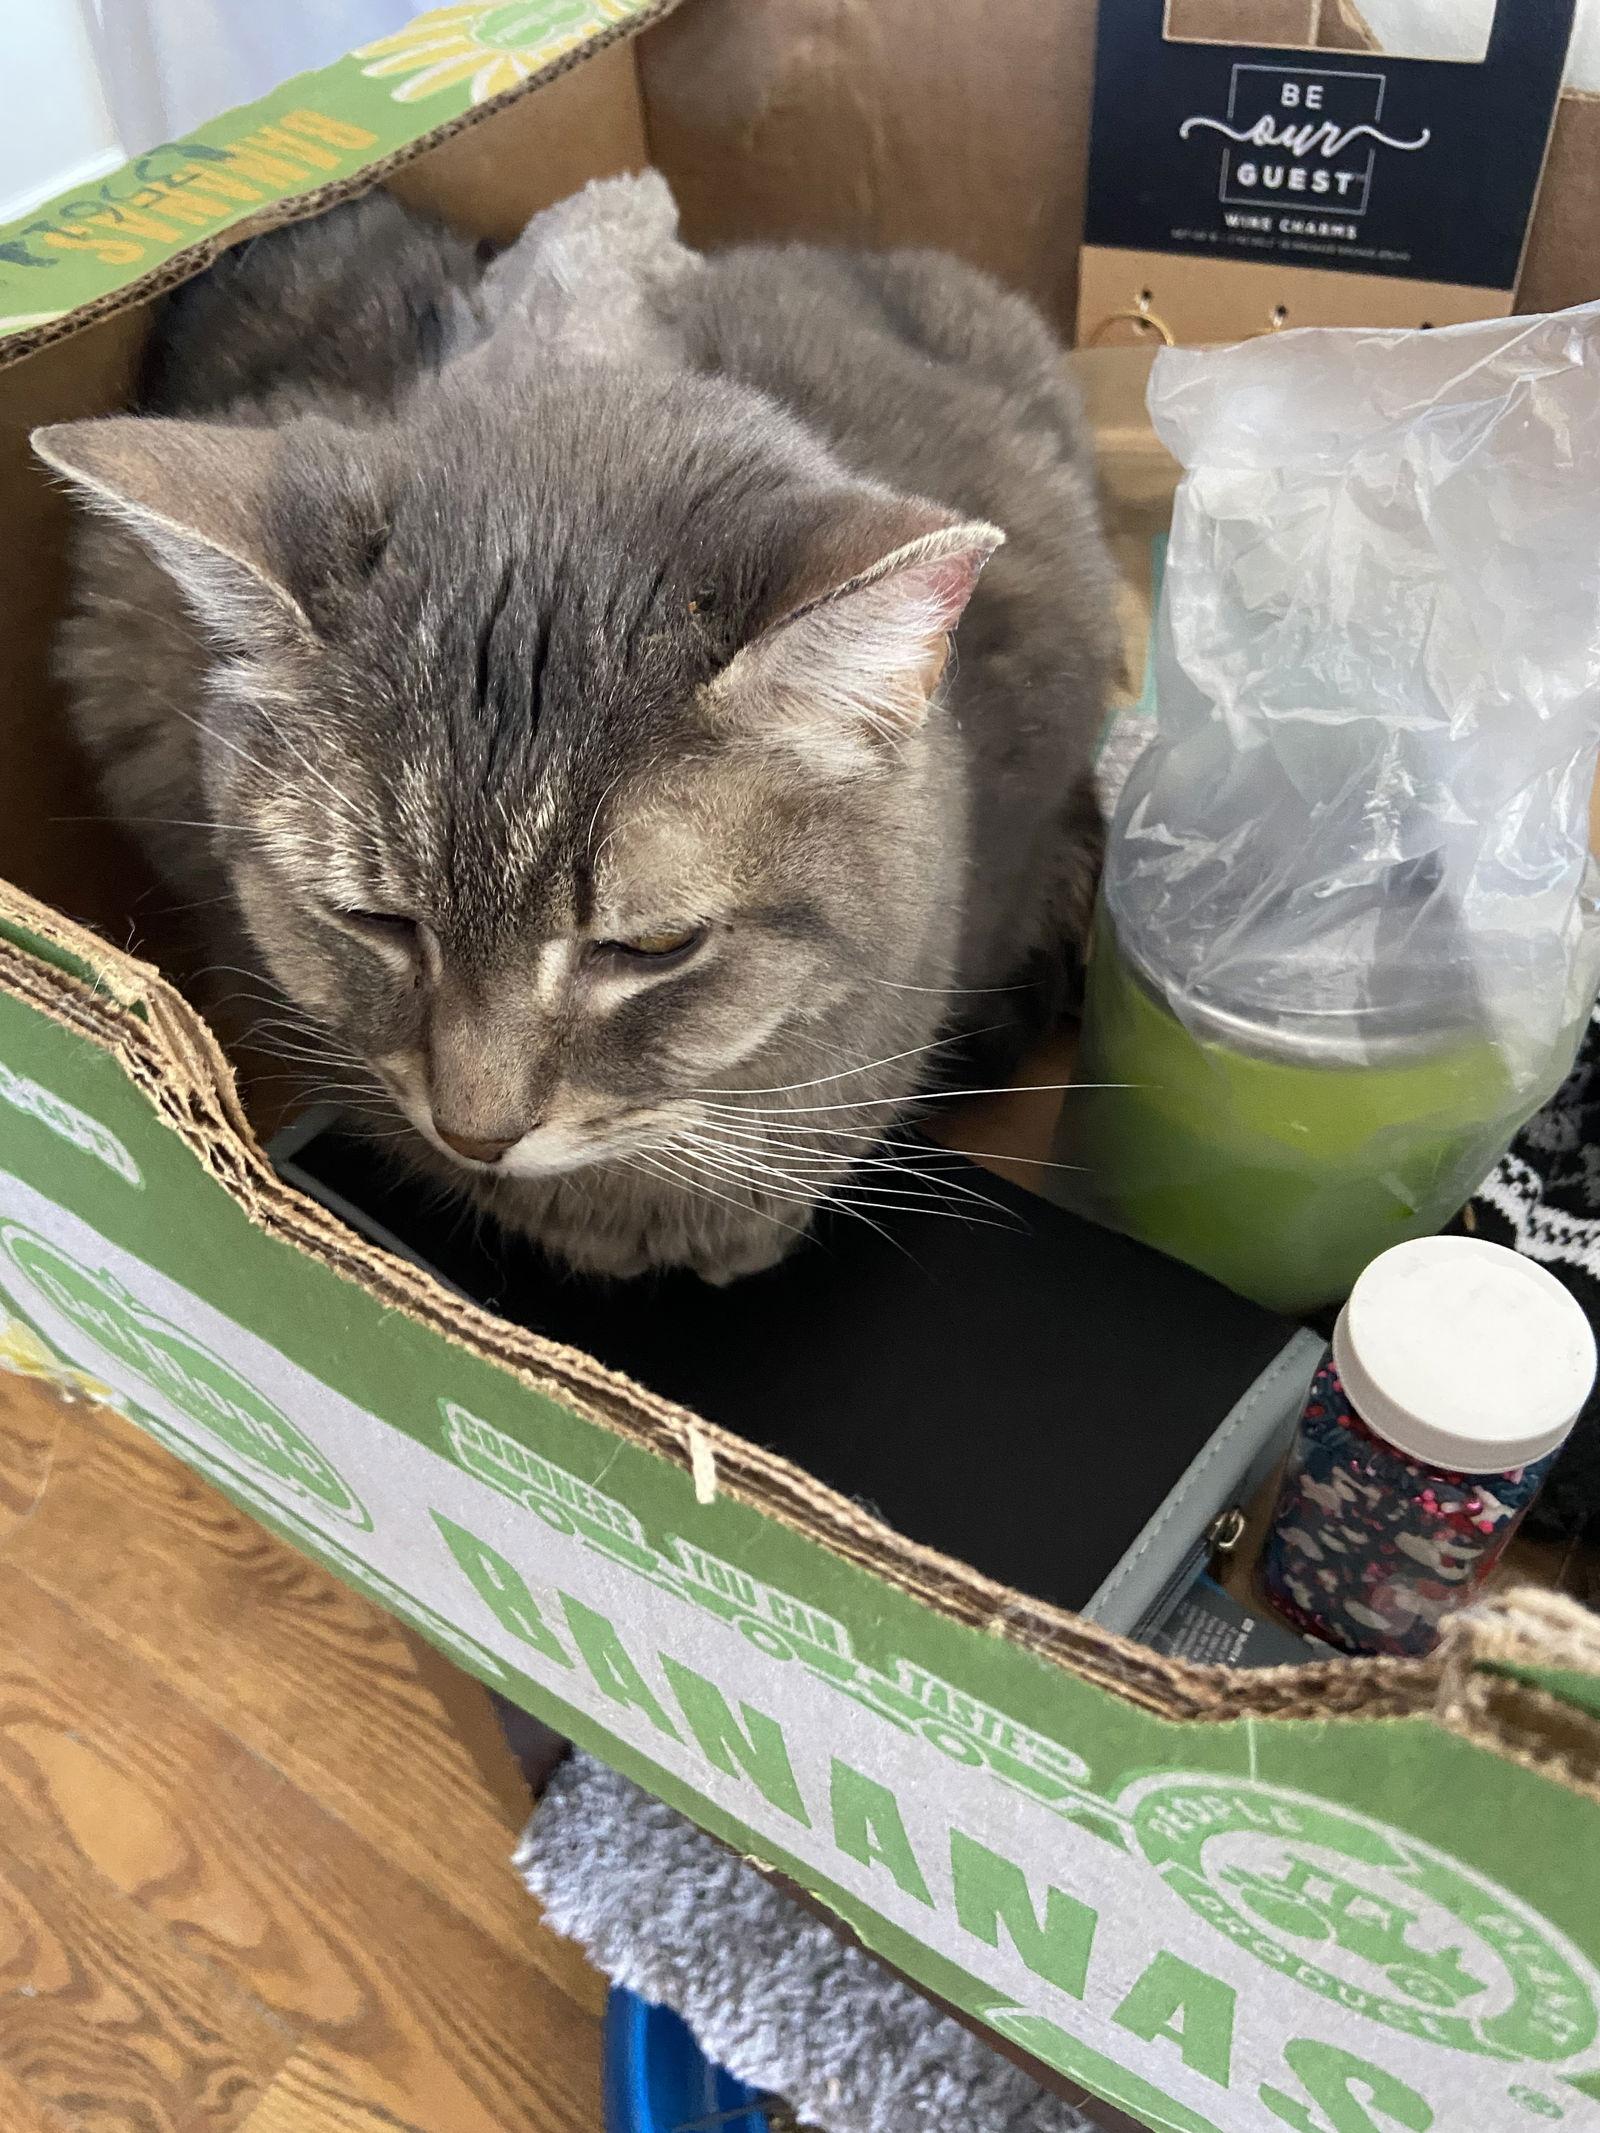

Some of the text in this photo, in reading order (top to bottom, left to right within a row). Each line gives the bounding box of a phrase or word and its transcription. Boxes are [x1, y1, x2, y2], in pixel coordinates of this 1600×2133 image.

[1281, 82, 1324, 110] BE
[1237, 162, 1352, 195] GUEST
[1224, 212, 1358, 241] WINE CHARMS
[455, 1410, 636, 1543] GOODNESS
[687, 1548, 839, 1652] YOU CAN
[429, 1507, 1434, 2133] BANANAS
[1148, 1795, 1303, 1844] PEOPLE
